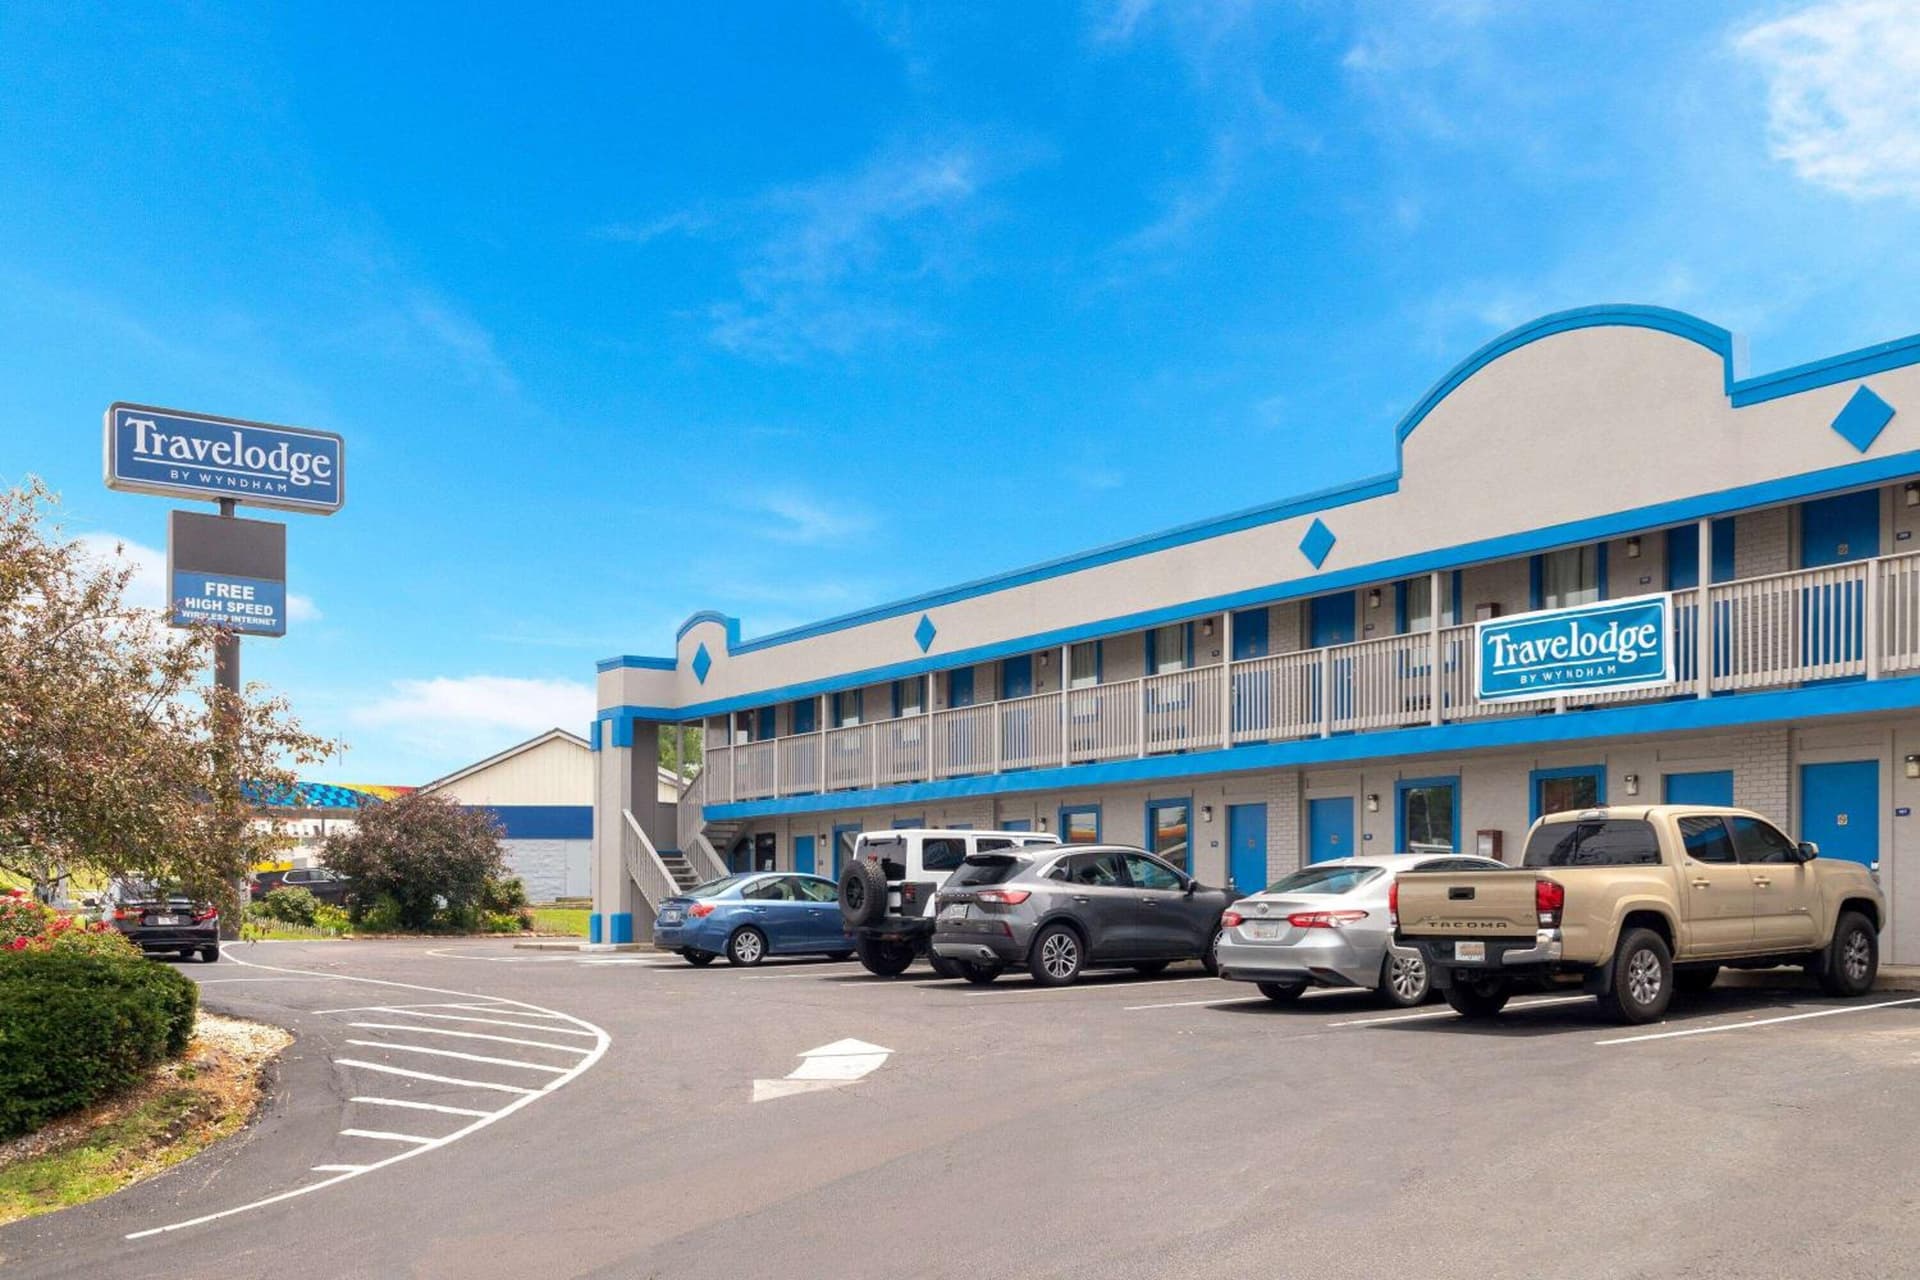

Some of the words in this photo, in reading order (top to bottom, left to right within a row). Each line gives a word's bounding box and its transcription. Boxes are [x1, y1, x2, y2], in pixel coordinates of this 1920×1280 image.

[125, 418, 332, 486] Travelodge
[171, 470, 190, 481] BY
[200, 473, 287, 493] WYNDHAM
[205, 582, 255, 600] FREE
[185, 597, 222, 611] HIGH
[226, 601, 273, 616] SPEED
[230, 615, 277, 626] INTERNET
[1488, 621, 1657, 664] Travelodge
[1520, 673, 1536, 685] BY
[1542, 665, 1617, 681] WYNDHAM
